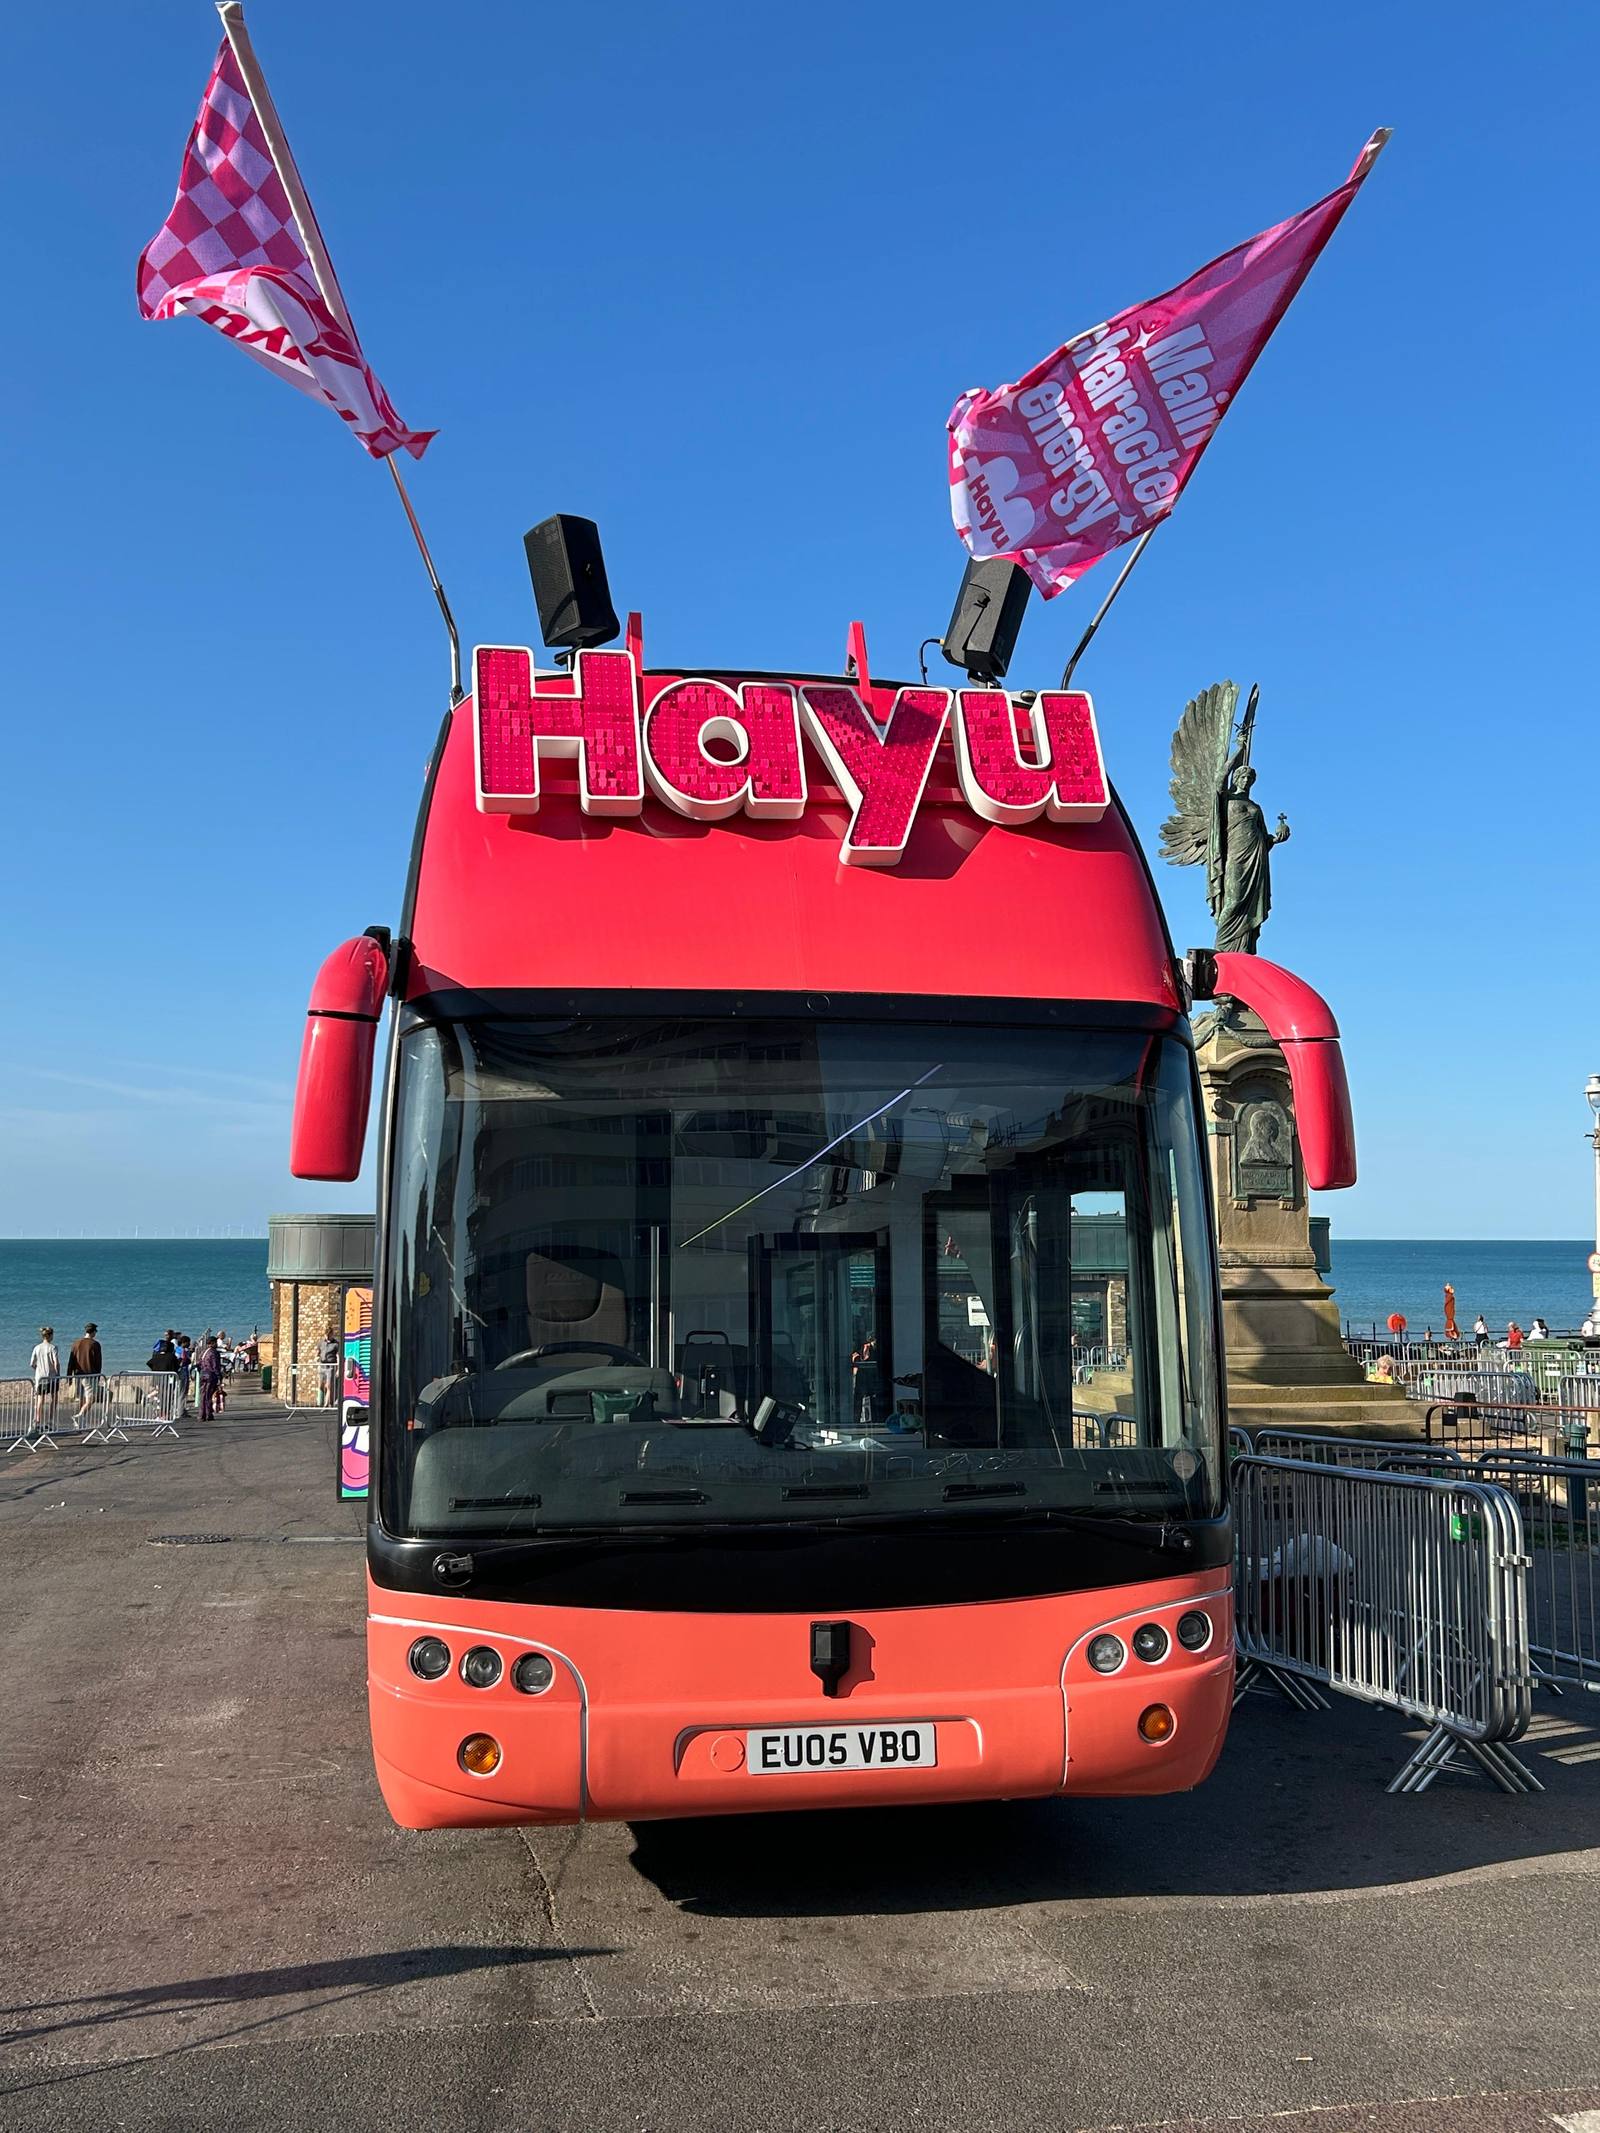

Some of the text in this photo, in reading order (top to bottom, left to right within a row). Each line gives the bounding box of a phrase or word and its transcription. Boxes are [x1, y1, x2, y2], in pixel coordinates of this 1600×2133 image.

[1143, 322, 1231, 450] Main
[967, 473, 1010, 549] Hayu
[1018, 381, 1119, 536] energy
[472, 645, 1111, 866] Hayu
[762, 1729, 921, 1768] EU05 VBO
